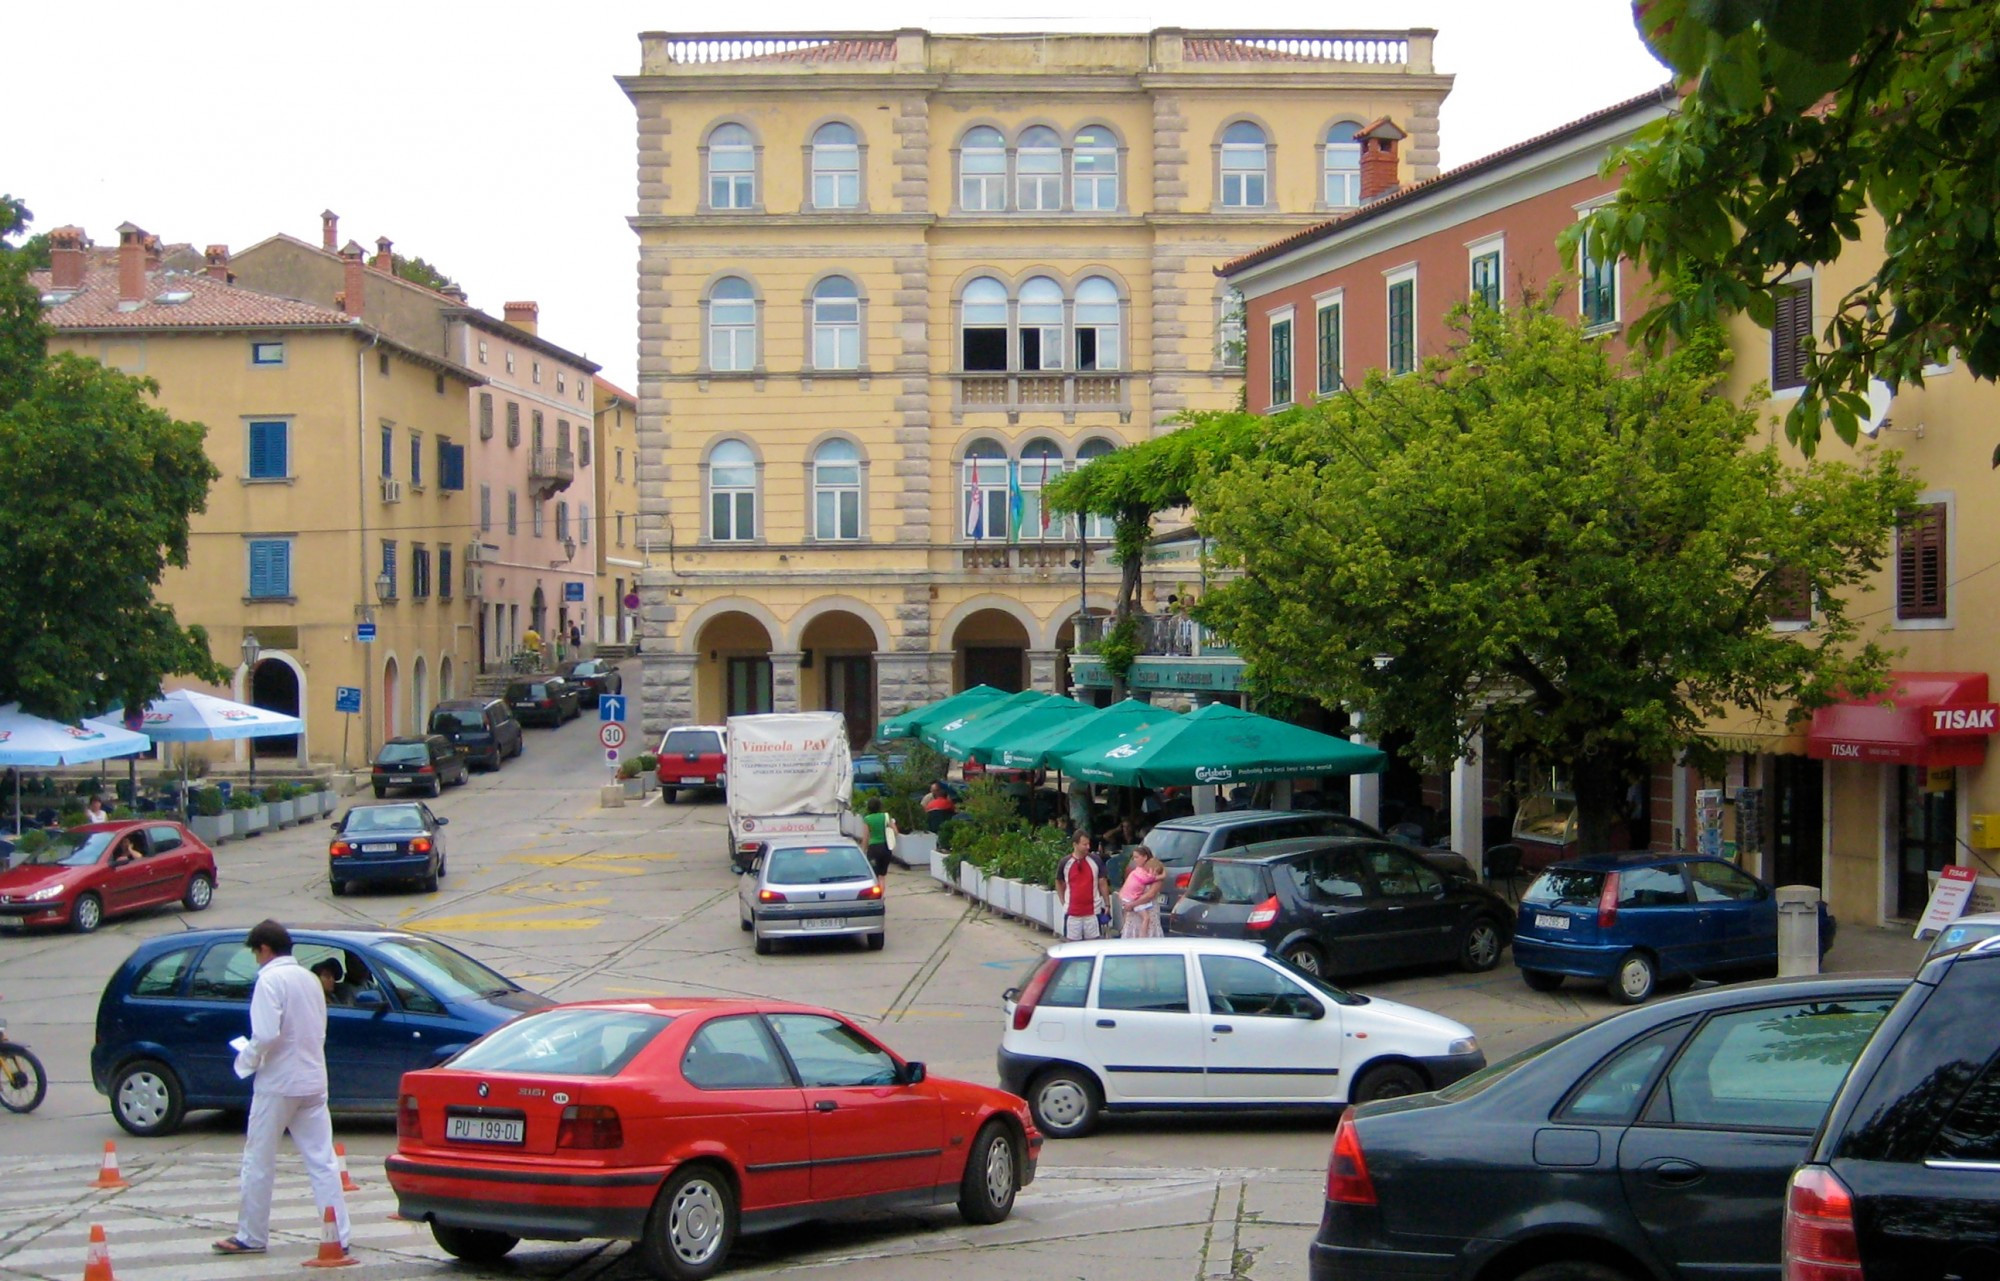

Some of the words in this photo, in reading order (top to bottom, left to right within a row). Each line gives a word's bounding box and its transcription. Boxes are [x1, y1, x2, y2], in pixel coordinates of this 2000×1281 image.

[1933, 708, 1996, 730] TISAK
[604, 728, 621, 743] 30
[741, 740, 793, 753] Vinicola
[803, 739, 829, 751] P&V
[1831, 744, 1860, 757] TISAK
[1195, 765, 1232, 782] Carlsberg
[1948, 868, 1969, 878] TISAK
[455, 1120, 470, 1136] PU
[480, 1122, 519, 1141] 199-DL
